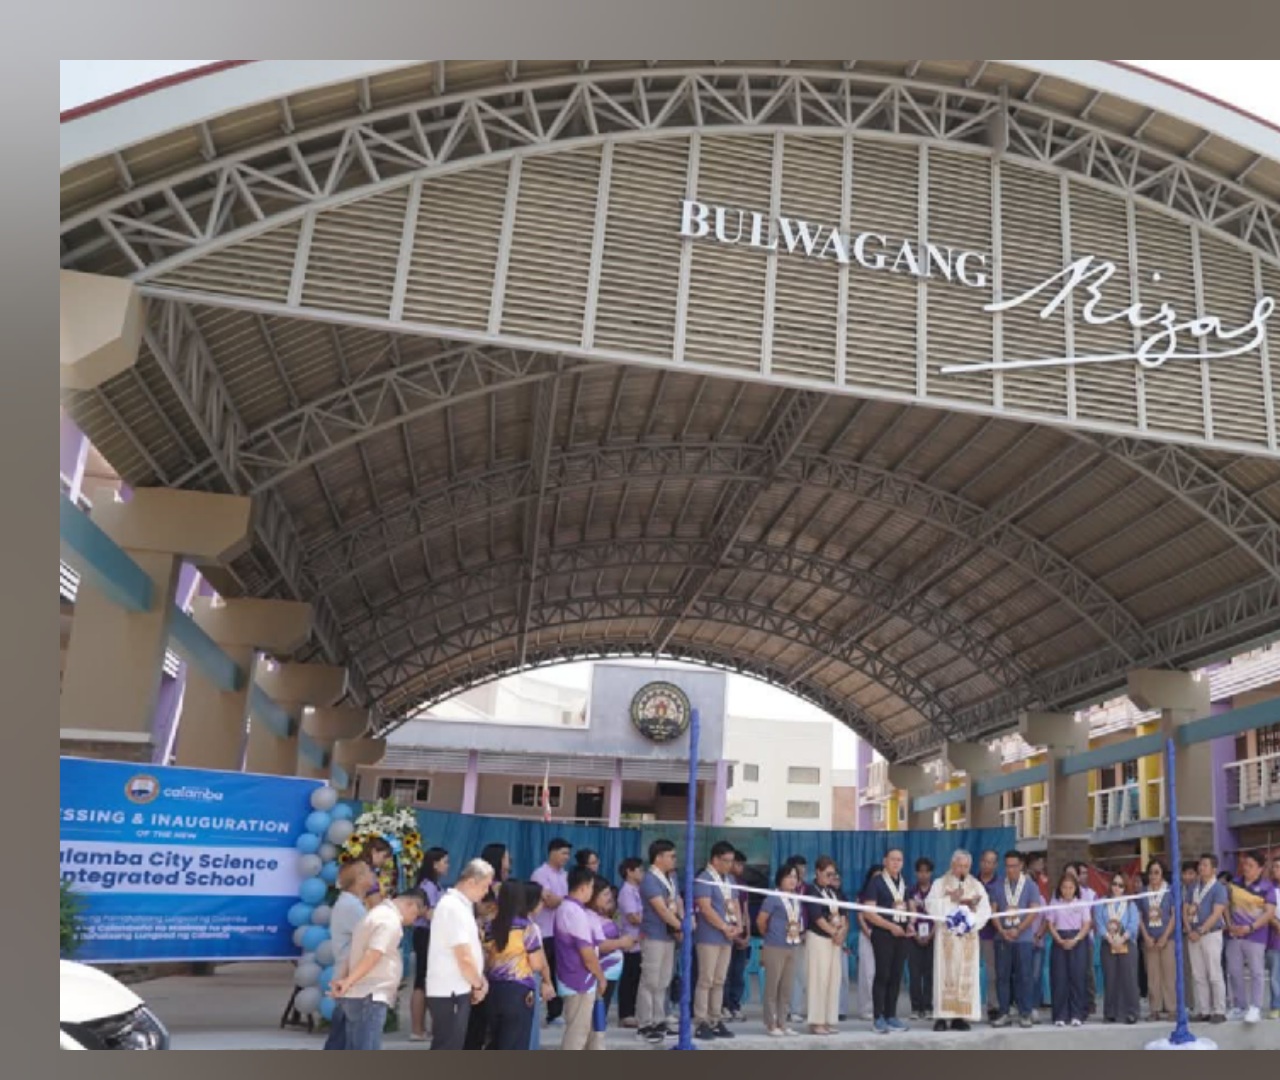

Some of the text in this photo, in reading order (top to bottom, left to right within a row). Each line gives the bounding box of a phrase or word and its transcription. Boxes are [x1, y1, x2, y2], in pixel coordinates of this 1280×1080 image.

[680, 199, 1275, 371] BULWAGANG Rizal
[60, 807, 290, 833] SSING & INAUGURATION
[149, 850, 193, 872] City
[199, 853, 279, 871] Science
[185, 870, 255, 887] School
